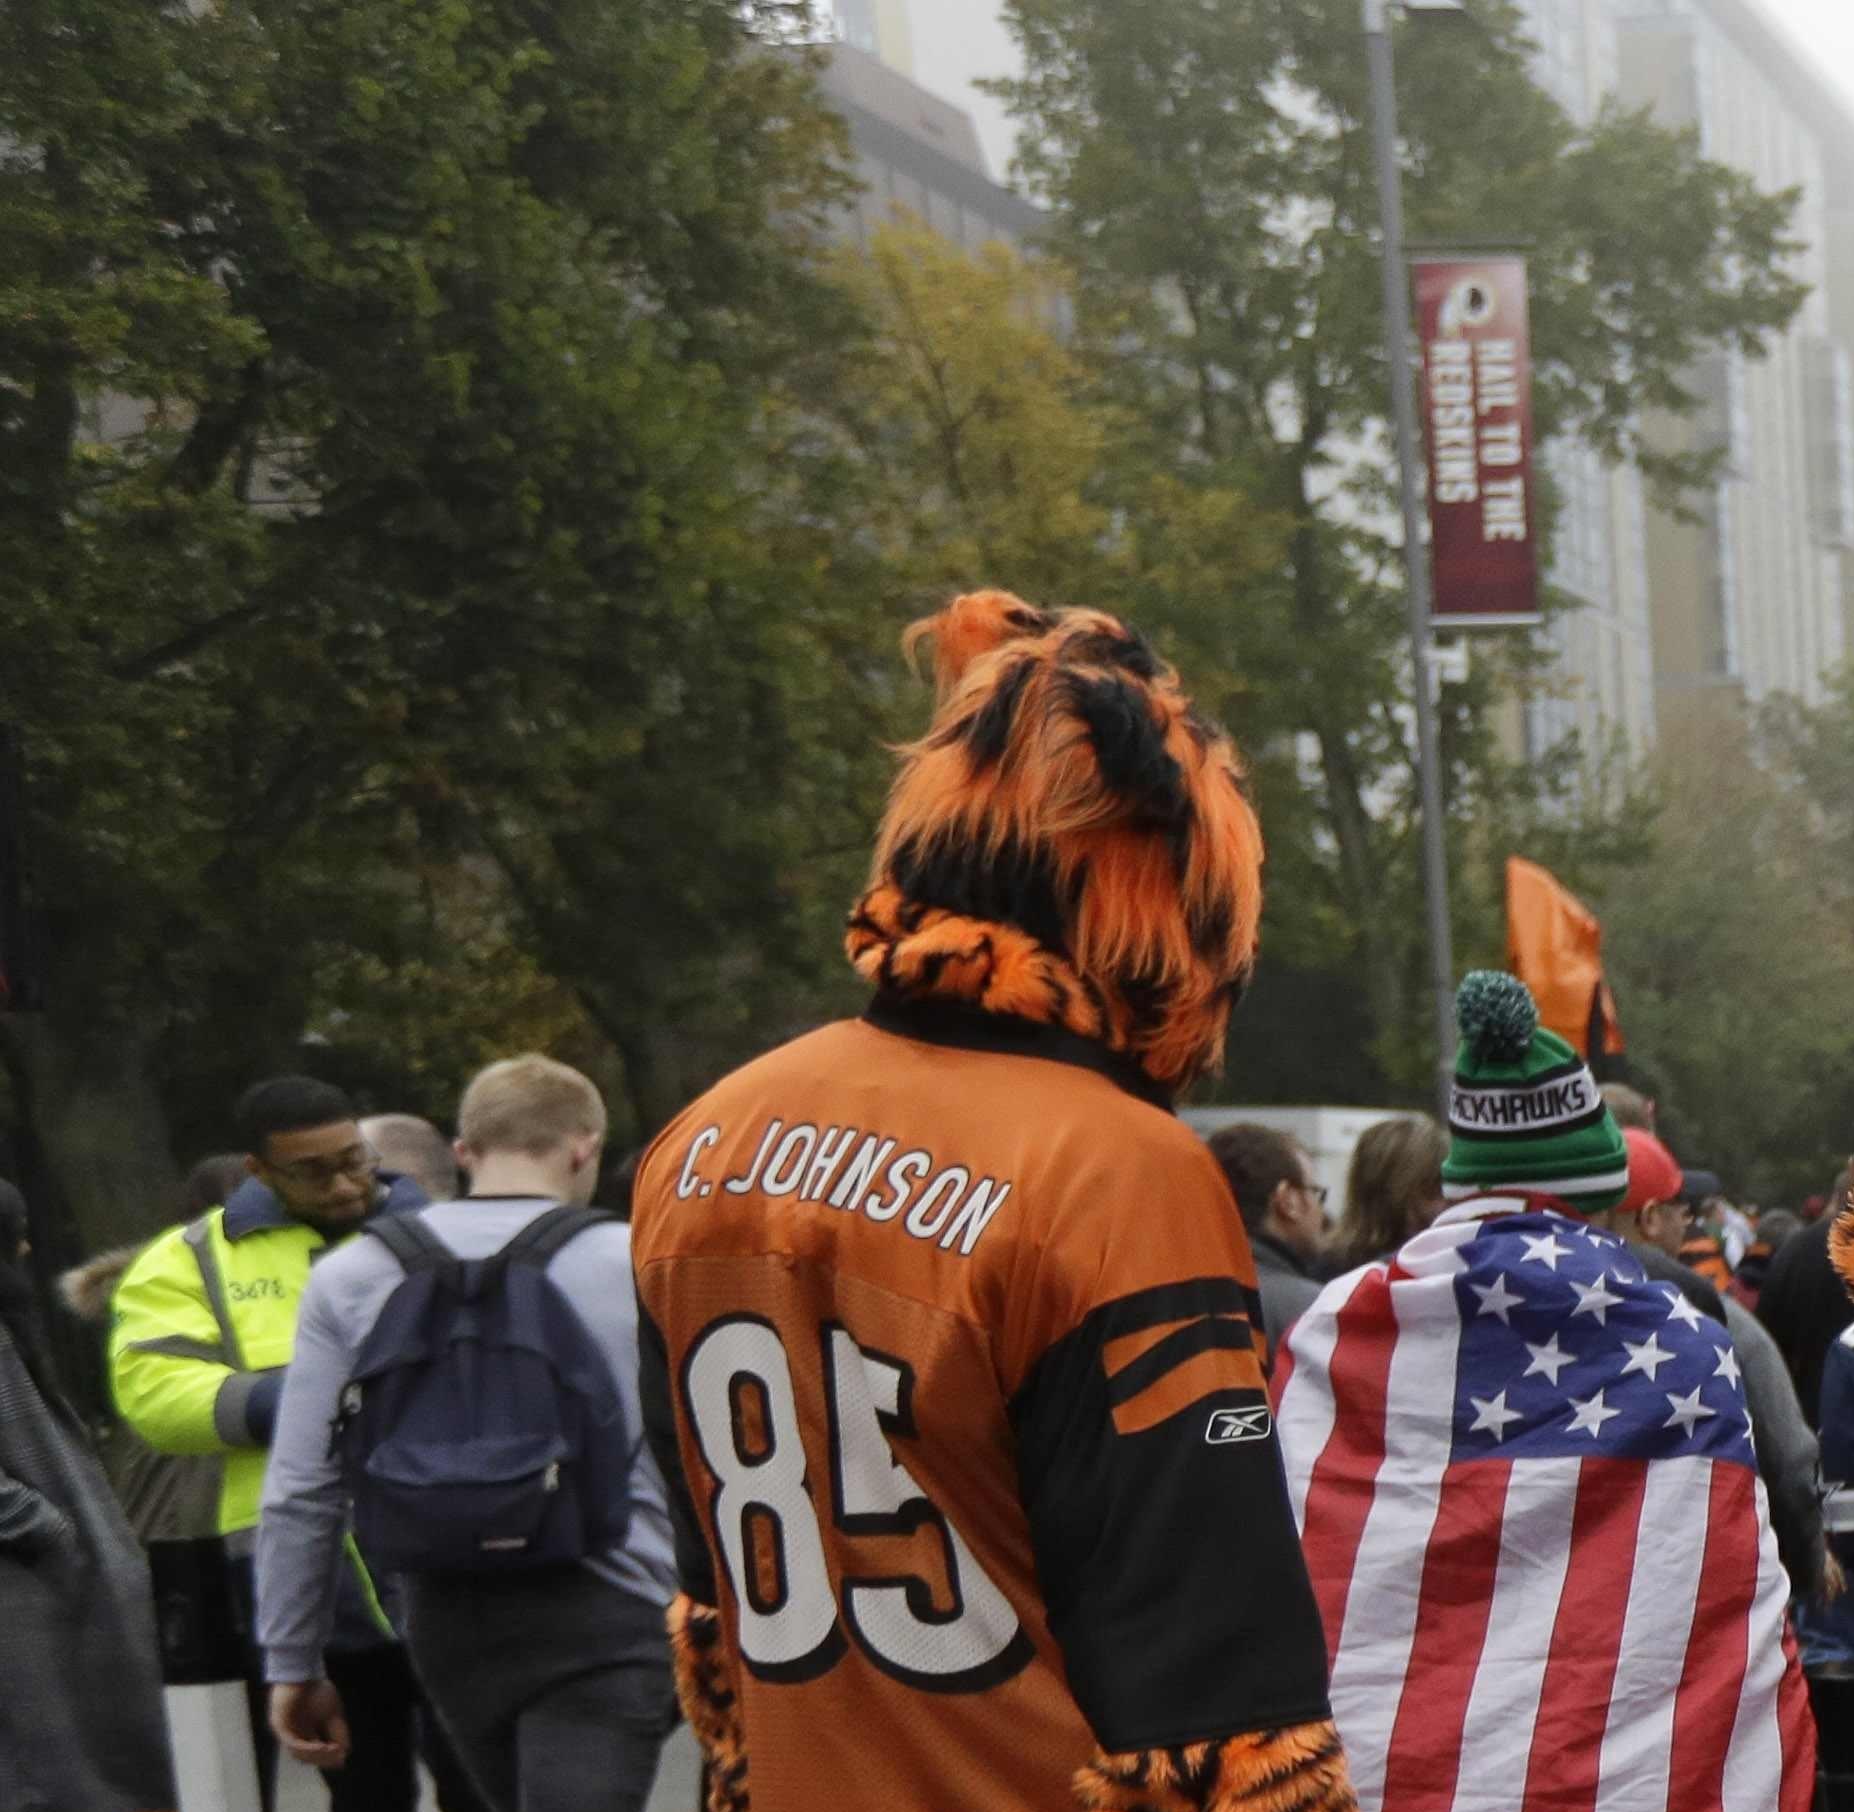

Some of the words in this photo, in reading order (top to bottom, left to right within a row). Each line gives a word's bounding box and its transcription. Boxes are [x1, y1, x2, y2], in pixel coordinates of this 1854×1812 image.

[1431, 341, 1479, 502] REDSKINS
[1476, 339, 1519, 416] HAIL
[1480, 421, 1523, 465] TO
[1481, 476, 1527, 542] THE
[678, 1125, 720, 1199] C.
[725, 1119, 1012, 1256] JOHNSON
[681, 1313, 1036, 1693] 85
